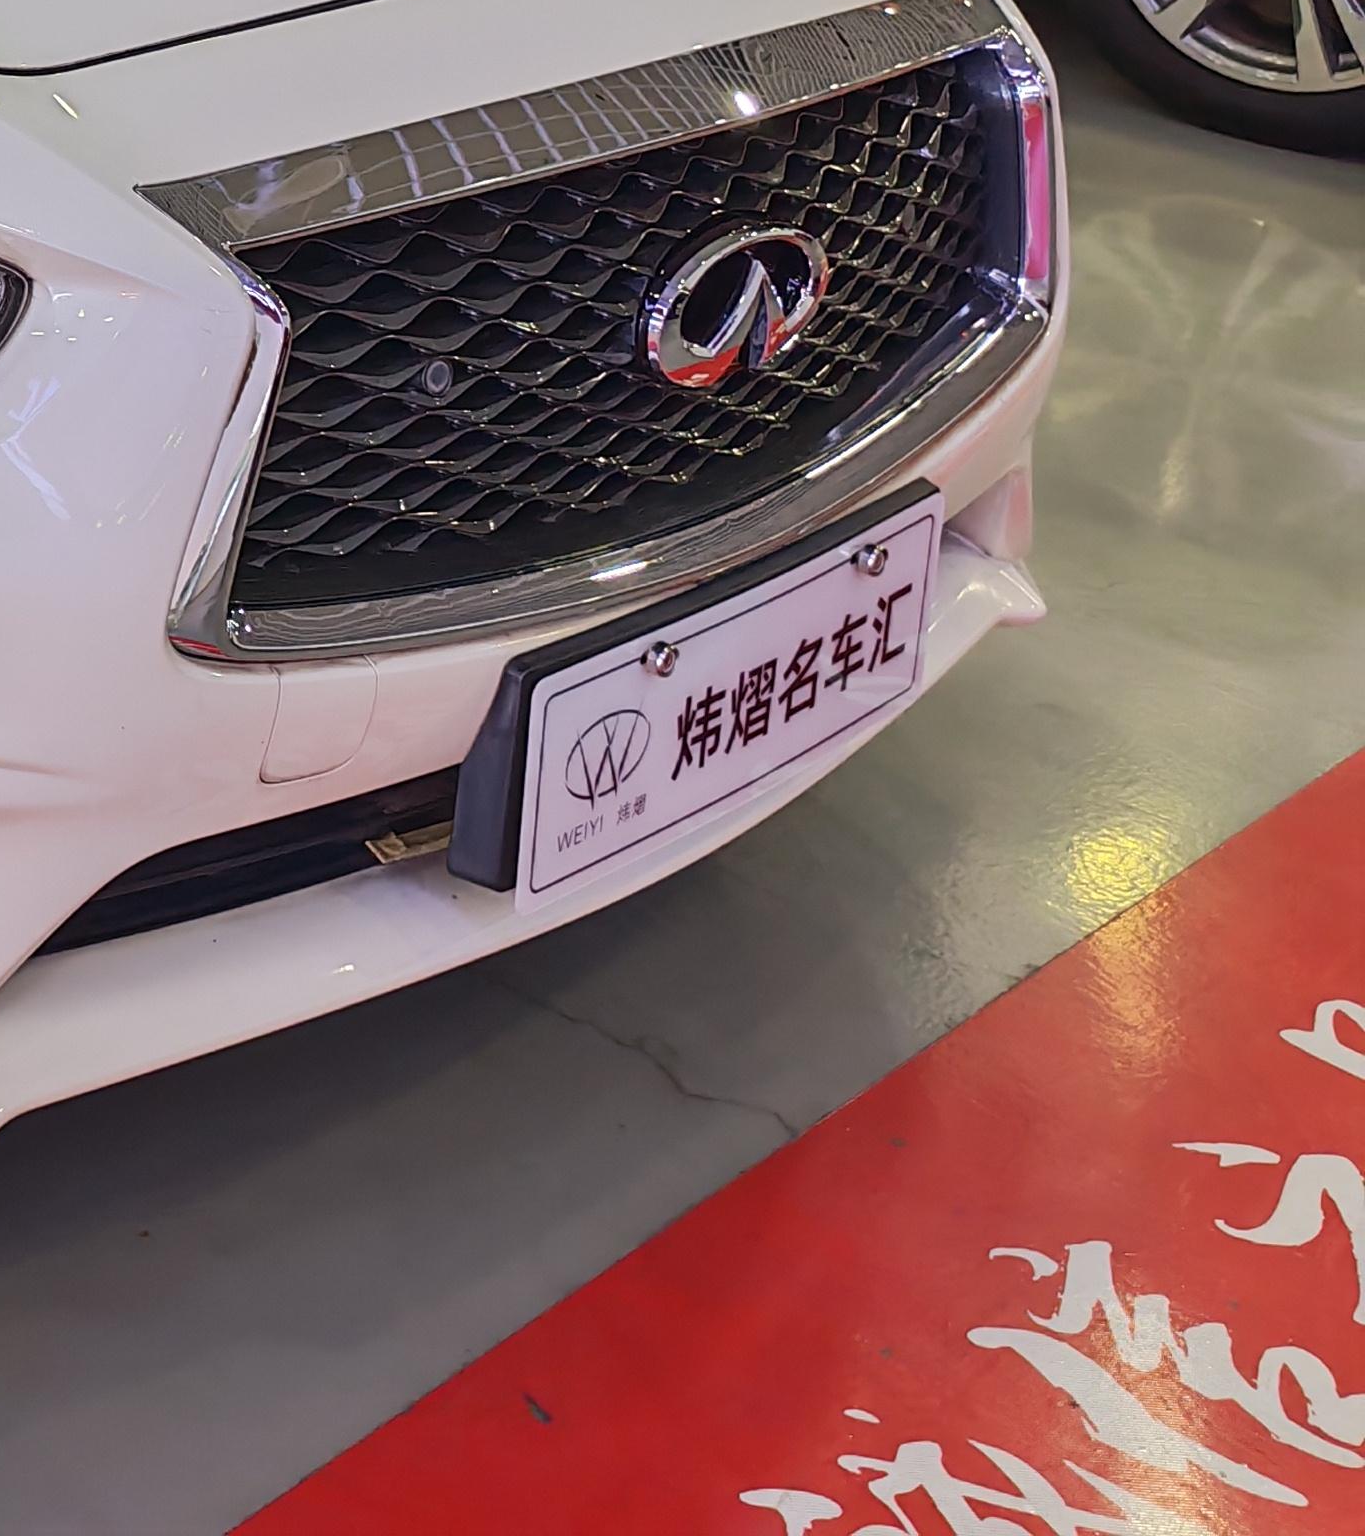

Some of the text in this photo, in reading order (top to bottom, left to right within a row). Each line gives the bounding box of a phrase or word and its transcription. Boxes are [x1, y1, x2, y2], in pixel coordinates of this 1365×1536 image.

[672, 583, 913, 781] 炜熠名车汇
[557, 814, 603, 852] WEIYI
